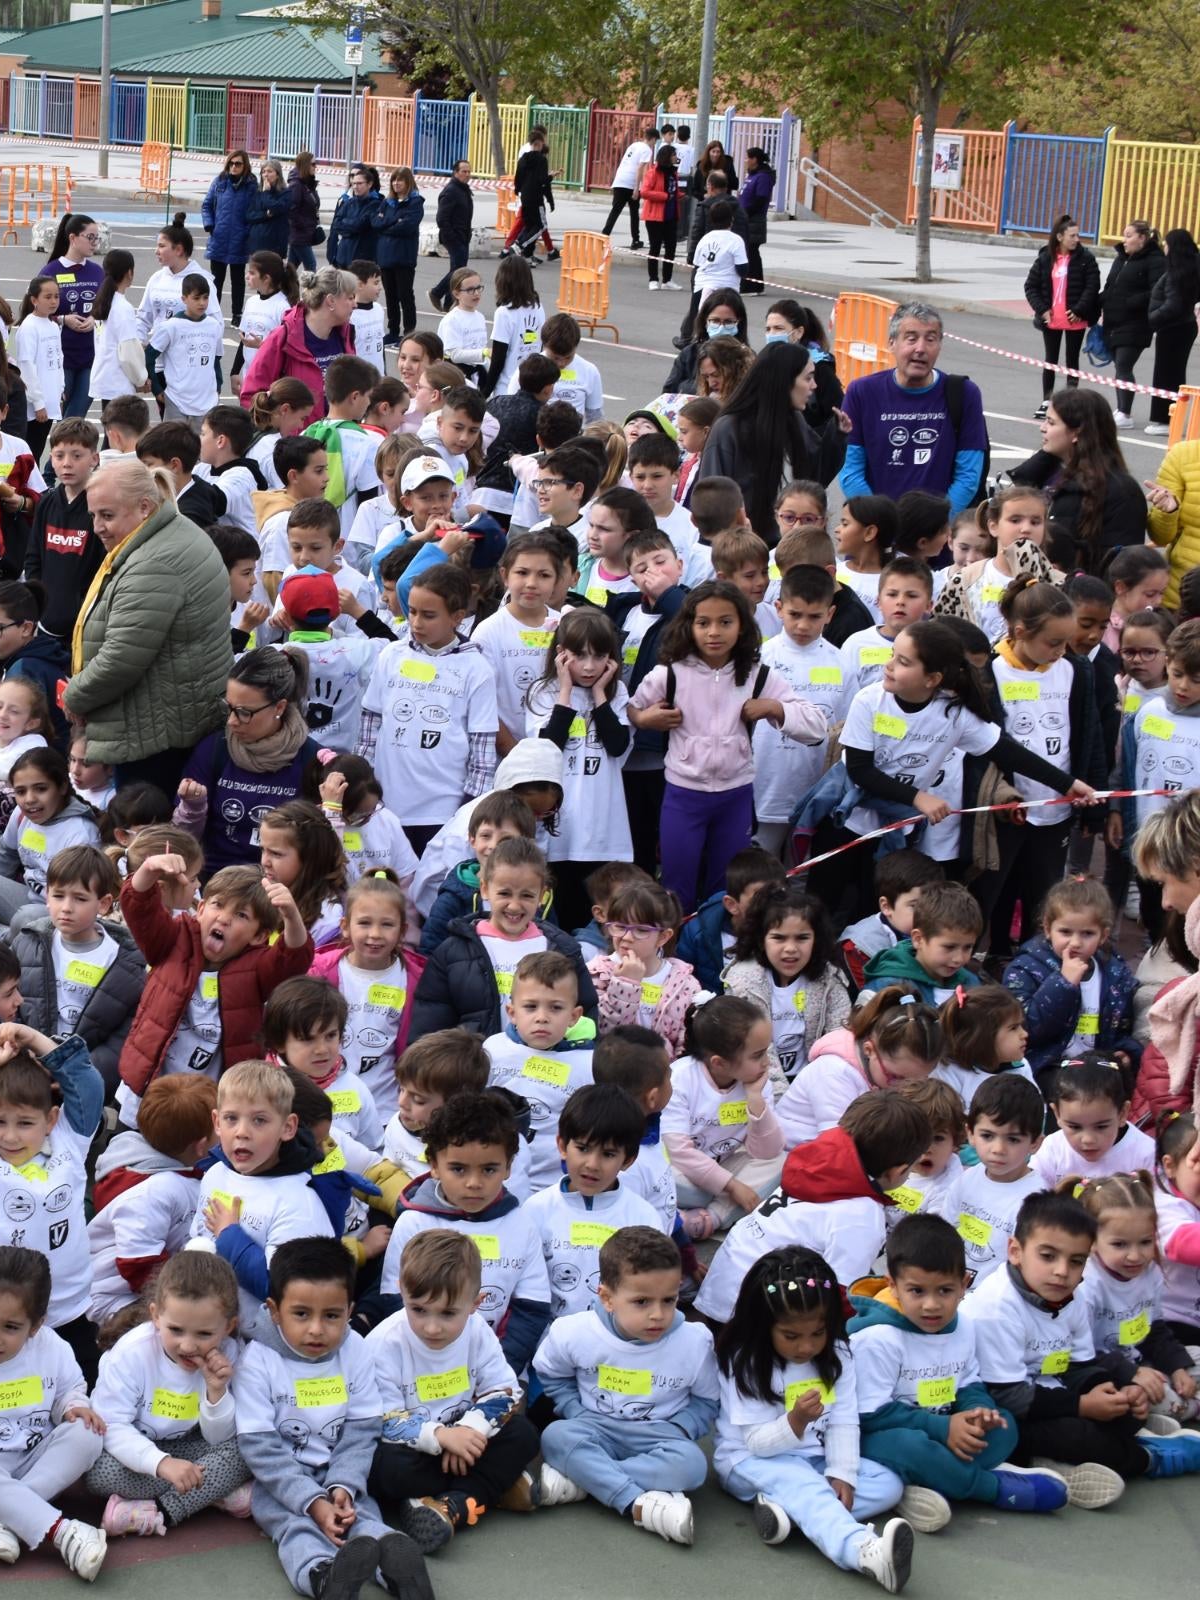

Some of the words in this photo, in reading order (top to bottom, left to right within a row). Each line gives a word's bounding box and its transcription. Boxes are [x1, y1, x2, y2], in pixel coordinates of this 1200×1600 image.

[526, 1061, 559, 1077] RAFAEL
[721, 1107, 748, 1120] SALMA
[426, 1376, 462, 1391] ALBERTO
[605, 1375, 630, 1386] ADAM
[930, 1386, 951, 1397] LUKA
[158, 1399, 186, 1411] YASMIN
